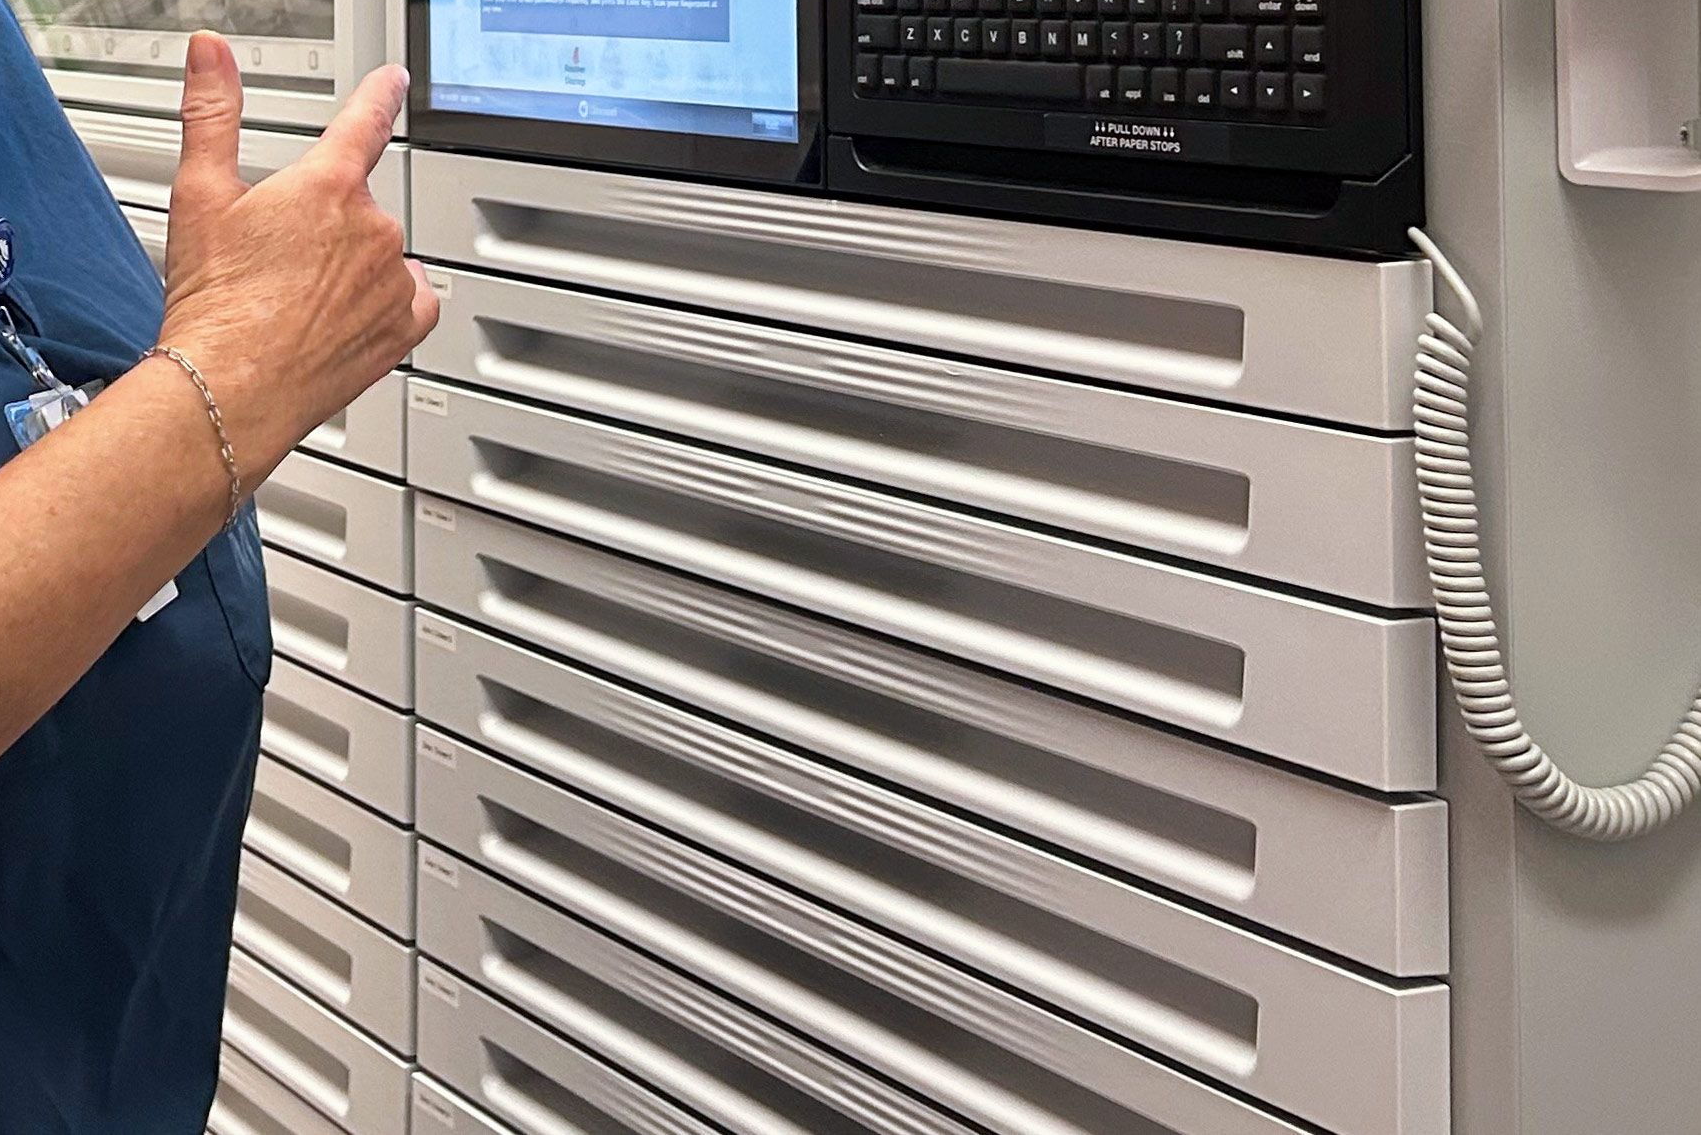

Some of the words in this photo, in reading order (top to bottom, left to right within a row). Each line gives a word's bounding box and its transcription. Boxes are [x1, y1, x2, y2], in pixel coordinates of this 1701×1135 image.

[906, 27, 915, 41] Z
[933, 28, 942, 41] X
[960, 28, 970, 43] C
[989, 30, 998, 43] V
[1017, 30, 1027, 45] B
[1047, 31, 1057, 45] N
[1077, 32, 1088, 46] M
[1107, 122, 1132, 135] PULL
[1131, 124, 1162, 137] DOWN
[1089, 135, 1119, 148] AFTER
[1118, 137, 1149, 150] PAPER
[1149, 139, 1181, 154] STOPS
